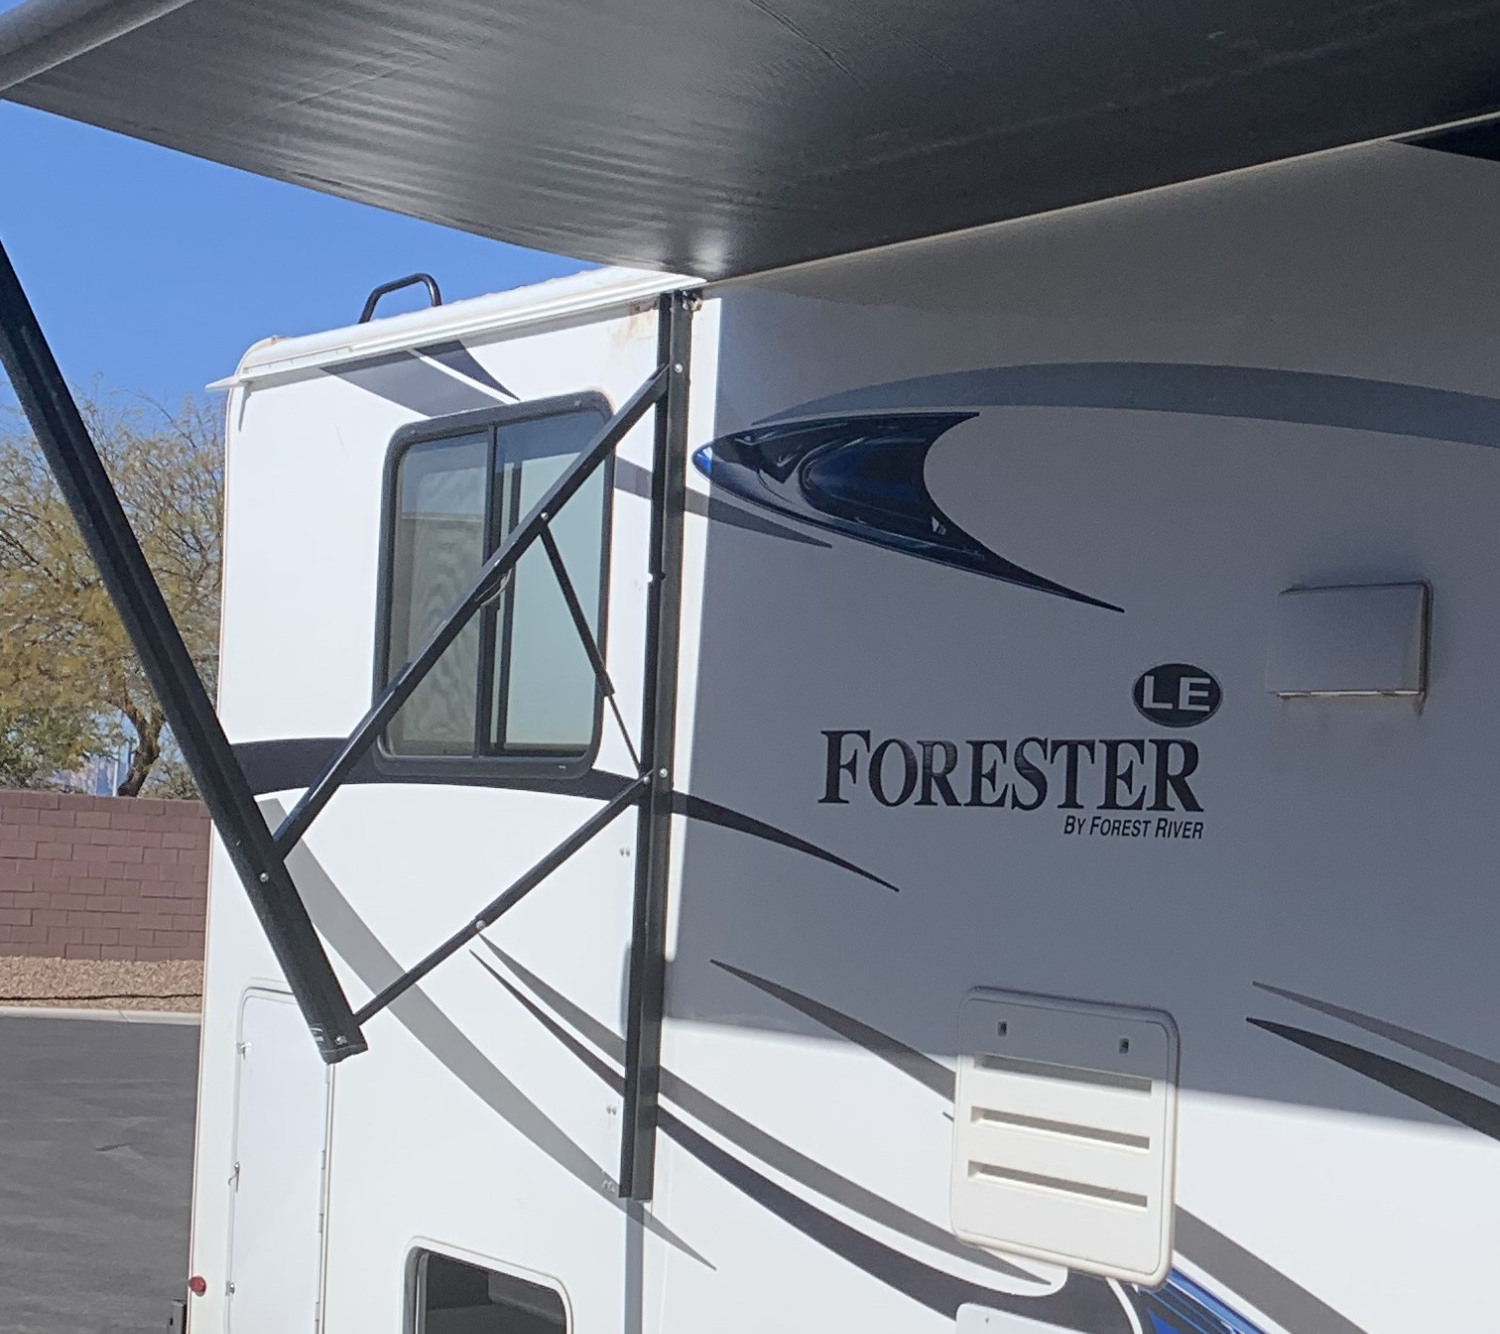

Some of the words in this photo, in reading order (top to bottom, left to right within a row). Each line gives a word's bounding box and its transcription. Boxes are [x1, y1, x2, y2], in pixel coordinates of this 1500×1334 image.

[1142, 675, 1211, 712] LE
[818, 728, 1204, 813] FORESTER
[1064, 814, 1086, 836] BY
[1089, 815, 1152, 838] FOREST
[1155, 816, 1204, 839] RIVER
